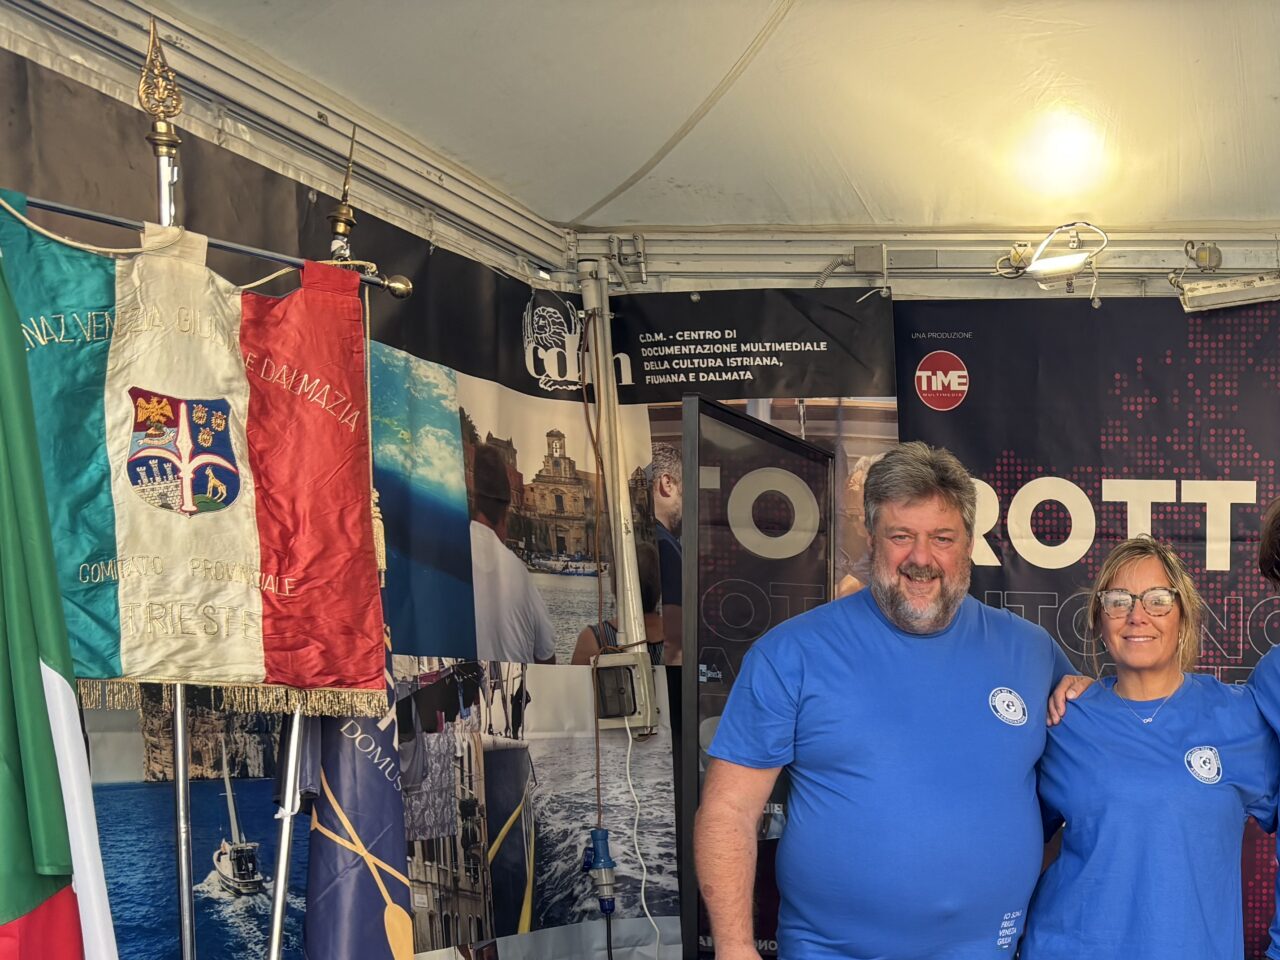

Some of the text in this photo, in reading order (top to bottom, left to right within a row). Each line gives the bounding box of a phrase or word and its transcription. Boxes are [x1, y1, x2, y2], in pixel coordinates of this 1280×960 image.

[638, 330, 667, 344] C.D.M.
[675, 330, 722, 341] CENTRO
[724, 329, 737, 340] DI
[911, 331, 974, 340] UNA PRODUZIONE
[640, 341, 828, 358] DOCUMENTAZIONE MULTIMEDIALE
[643, 355, 784, 371] DELLA CULTURA ISTRIANA,
[645, 370, 754, 385] FIUMANA E DALMATA
[259, 356, 362, 432] DALMAZIA
[78, 555, 299, 596] COMITATO PROVINCIALE
[121, 601, 263, 641] TRIESTE
[339, 719, 402, 792] DOMUS
